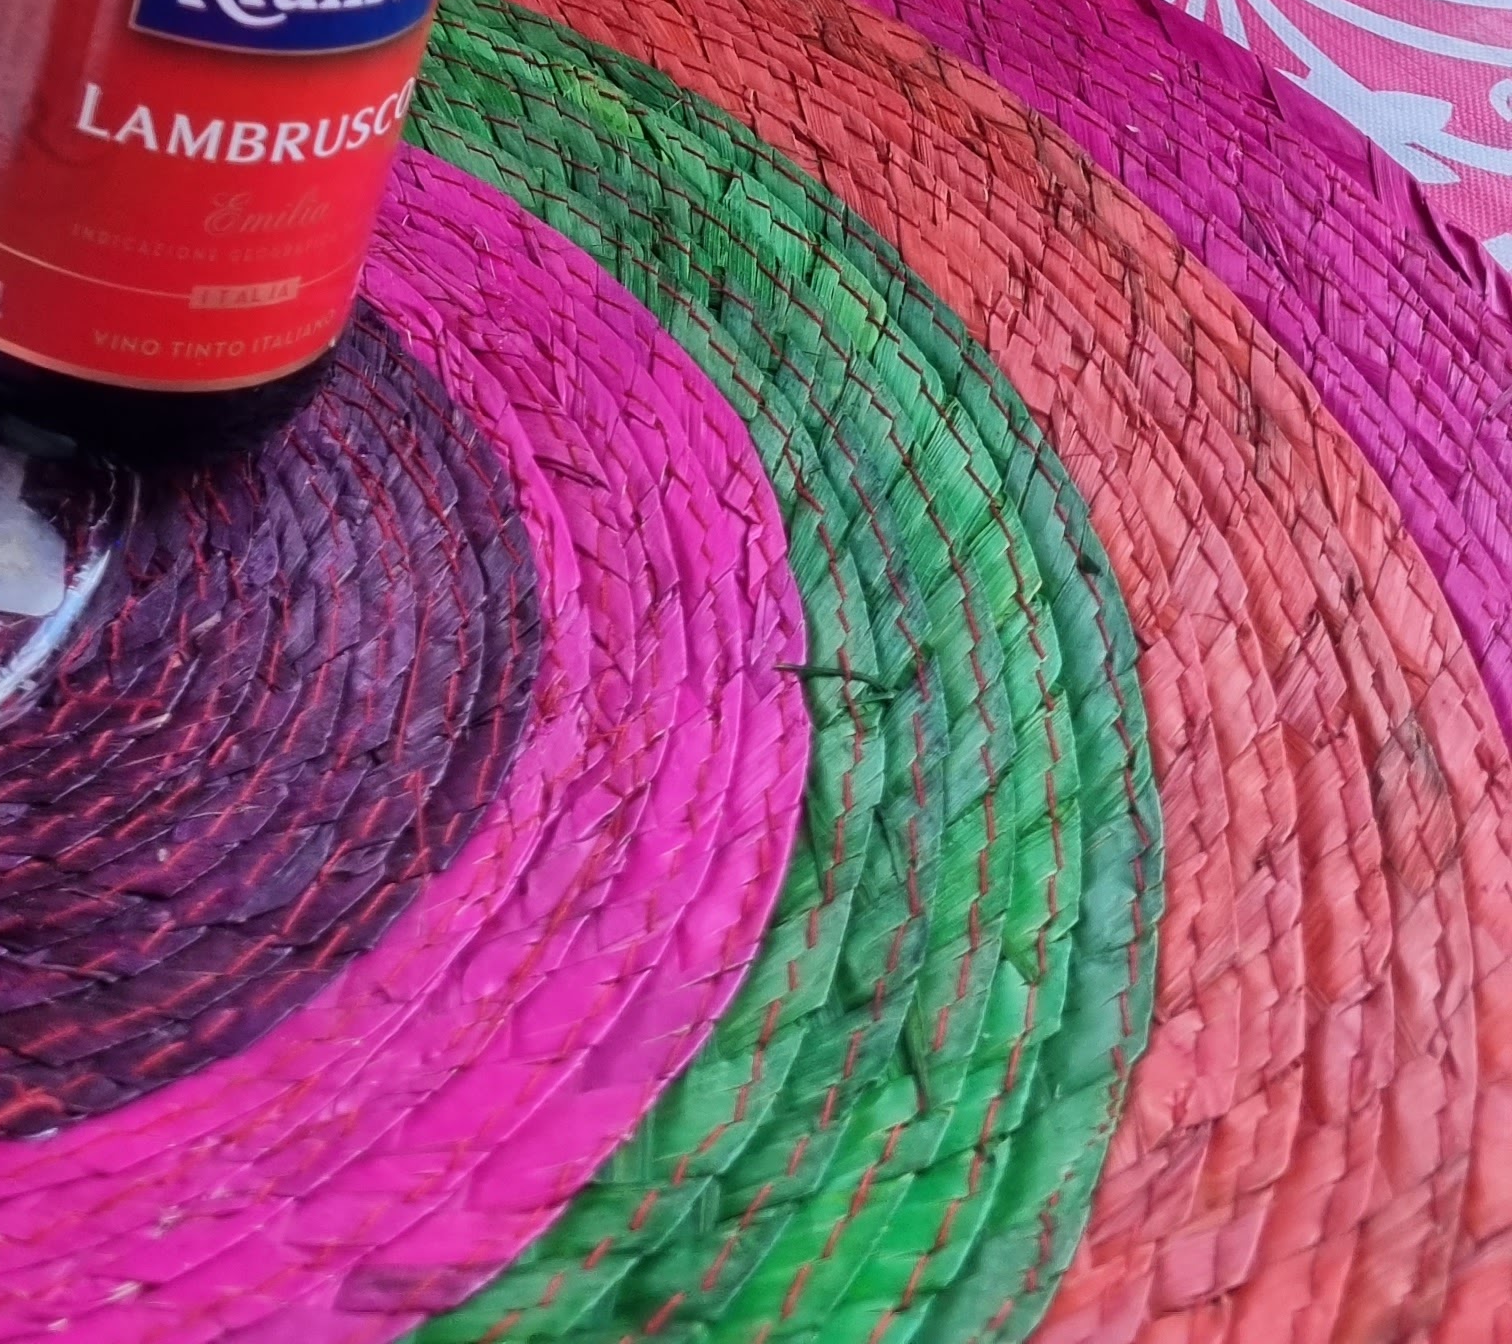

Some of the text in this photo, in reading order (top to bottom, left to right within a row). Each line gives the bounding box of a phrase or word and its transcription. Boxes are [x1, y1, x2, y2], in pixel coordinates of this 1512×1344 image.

[76, 80, 416, 163] LAMBRUSCO
[203, 186, 331, 235] Emilia
[199, 284, 290, 305] ITALIA
[93, 308, 338, 359] VINO TINTO ITALIANO
